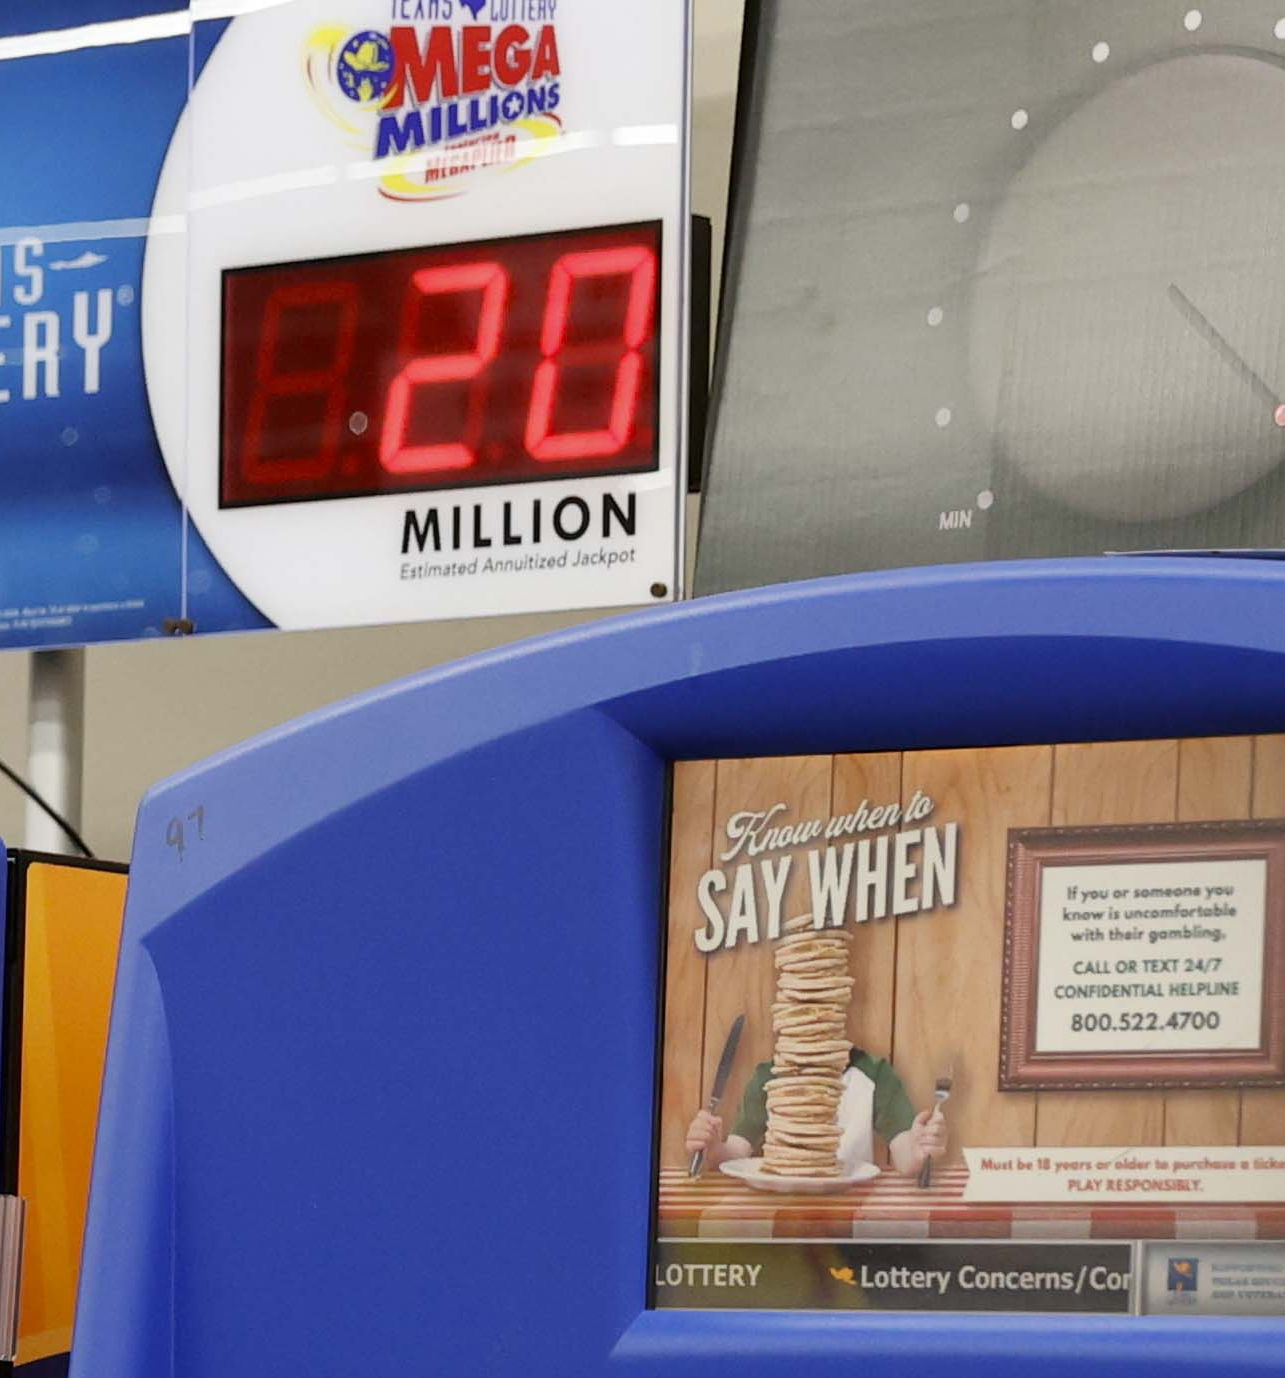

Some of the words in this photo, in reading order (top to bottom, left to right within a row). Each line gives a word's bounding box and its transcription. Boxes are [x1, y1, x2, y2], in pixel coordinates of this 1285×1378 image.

[380, 24, 560, 110] MEGA
[375, 83, 560, 160] MILLIONS
[380, 246, 657, 472] 20
[401, 492, 636, 554] MILLION
[938, 509, 972, 531] MIN
[400, 558, 478, 580] Estimated
[482, 551, 568, 574] Annuitized
[572, 547, 636, 568] Jackpot
[720, 802, 822, 862] Know
[825, 799, 903, 841] when
[902, 789, 934, 826] to
[693, 852, 794, 953] SAY
[806, 822, 959, 931] WHEN
[1067, 886, 1078, 901] If
[1081, 889, 1109, 904] you
[1112, 888, 1129, 900] or
[1133, 886, 1201, 900] someone
[1204, 885, 1234, 899] you
[1063, 907, 1106, 921] know
[1108, 907, 1120, 920] is
[1123, 903, 1237, 919] uncomfortable
[1071, 928, 1105, 942] with
[1108, 926, 1145, 941] their
[1072, 959, 1112, 975] CALL
[1115, 959, 1137, 974] OR
[1141, 959, 1180, 974] TEXT
[1183, 957, 1223, 975] 24/7
[1054, 982, 1164, 999] CONFIDENTIAL
[1168, 981, 1239, 997] HELPLINE
[1070, 1010, 1221, 1033] 800.522.4700
[980, 1158, 1017, 1171] Must
[1020, 1158, 1033, 1171] be
[1037, 1158, 1051, 1171] 18
[1054, 1160, 1091, 1175] years
[1095, 1161, 1111, 1171] or
[1155, 1159, 1170, 1171] to
[1172, 1158, 1237, 1175] purchase
[1240, 1161, 1250, 1171] a
[1067, 1178, 1102, 1193] PLAY
[656, 1264, 762, 1288] LOTTERY
[860, 1263, 949, 1295] Lottery
